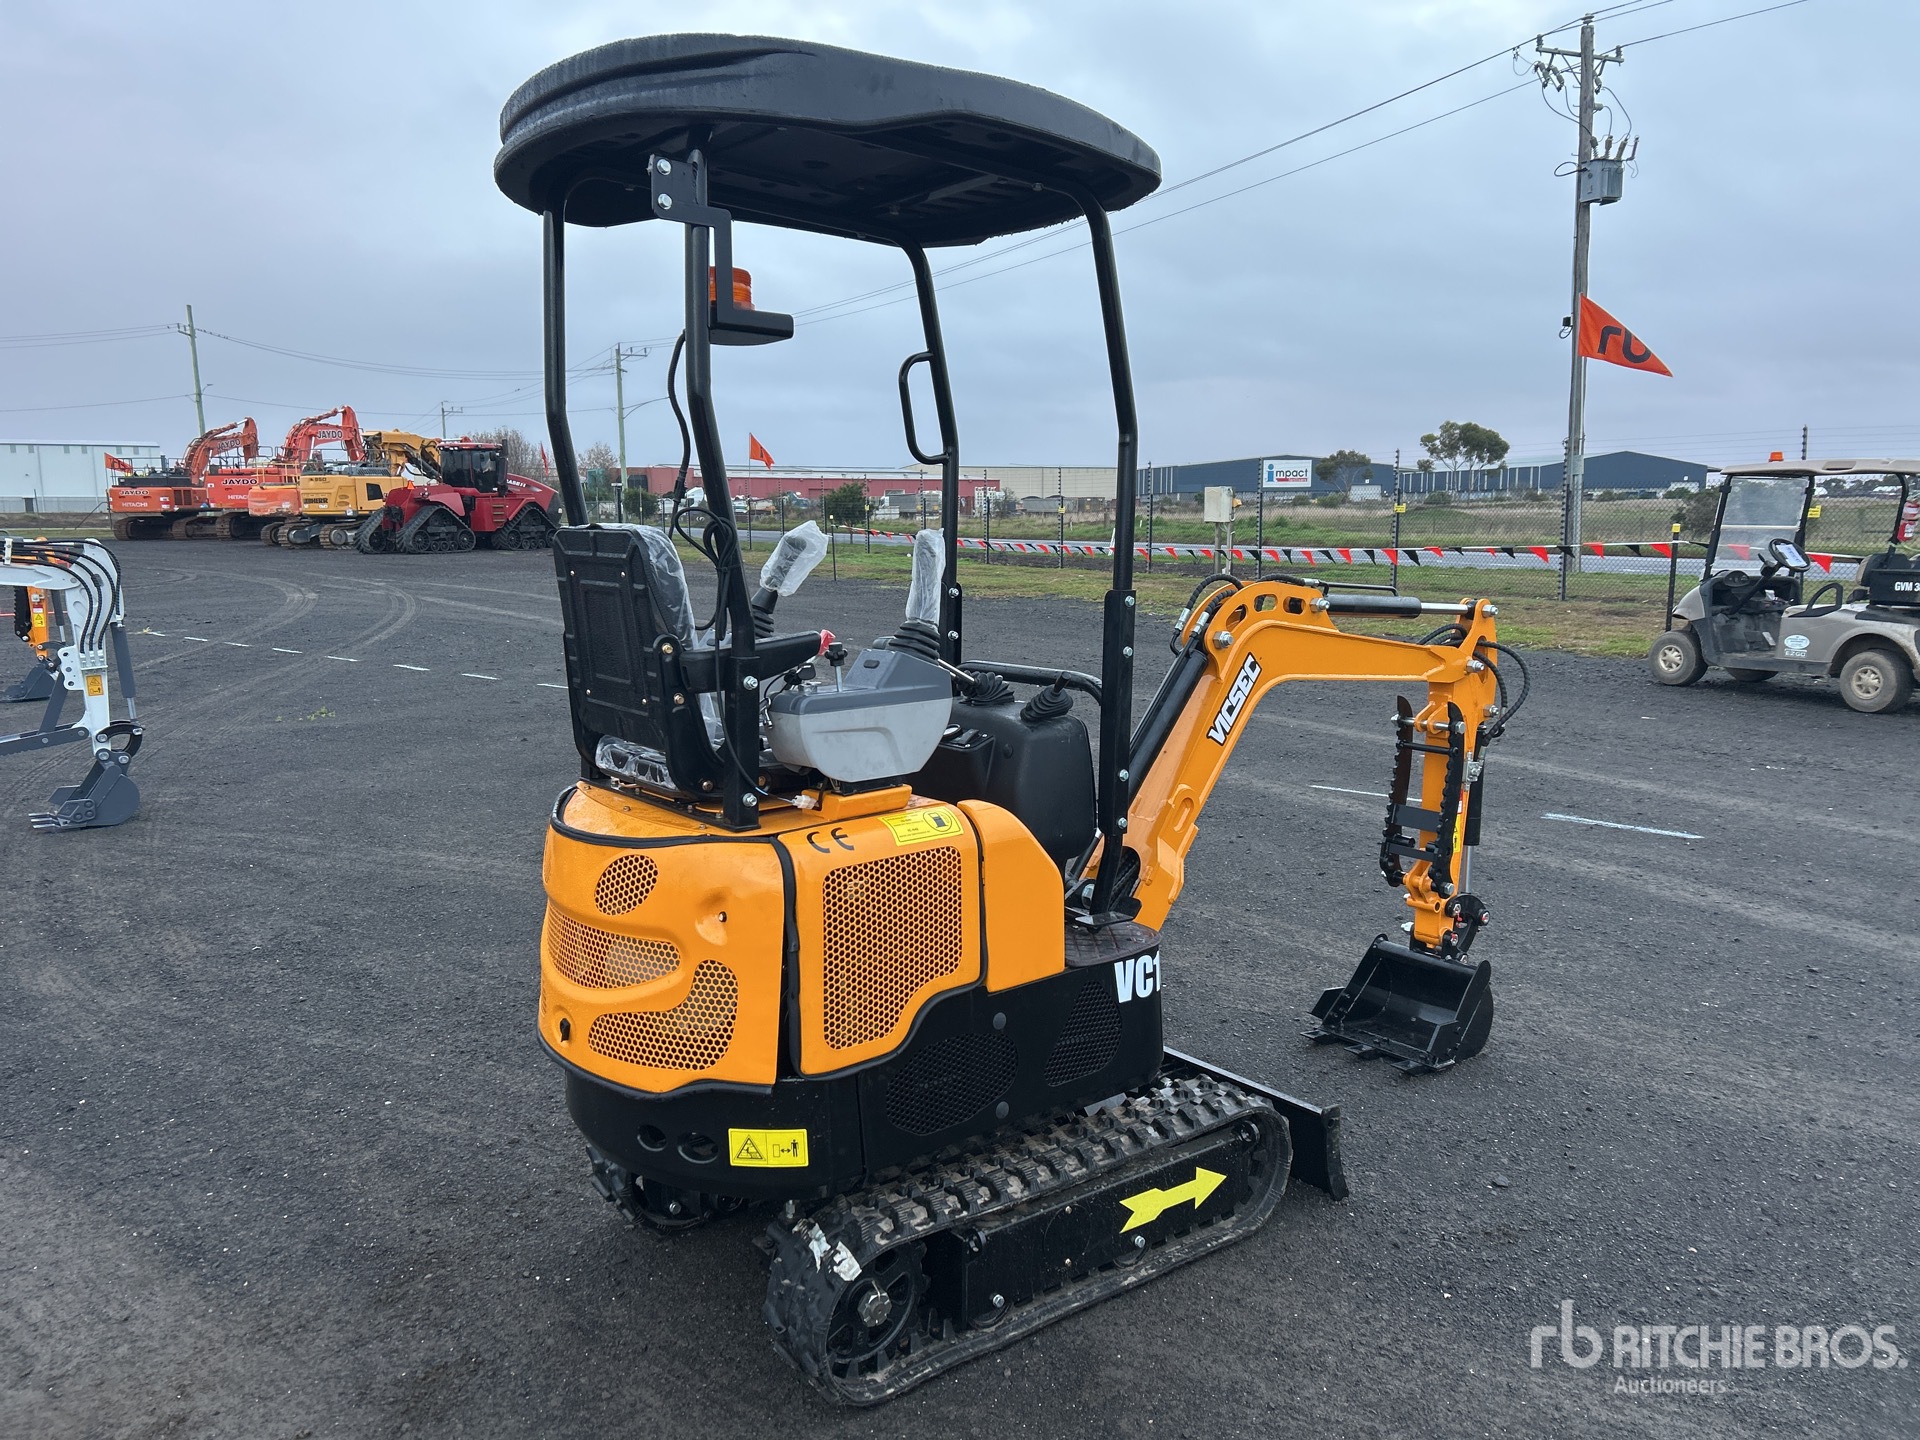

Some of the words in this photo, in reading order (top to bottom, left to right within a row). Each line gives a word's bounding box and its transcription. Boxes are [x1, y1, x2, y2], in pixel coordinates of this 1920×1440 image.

[317, 430, 343, 439] JAYDO
[217, 439, 241, 450] JAYDO
[1266, 463, 1308, 482] impact
[1894, 581, 1913, 592] GVM
[1913, 582, 1920, 592] 3
[1207, 653, 1262, 745] VICSEC
[806, 827, 855, 854] CE
[1113, 950, 1160, 1003] VC1
